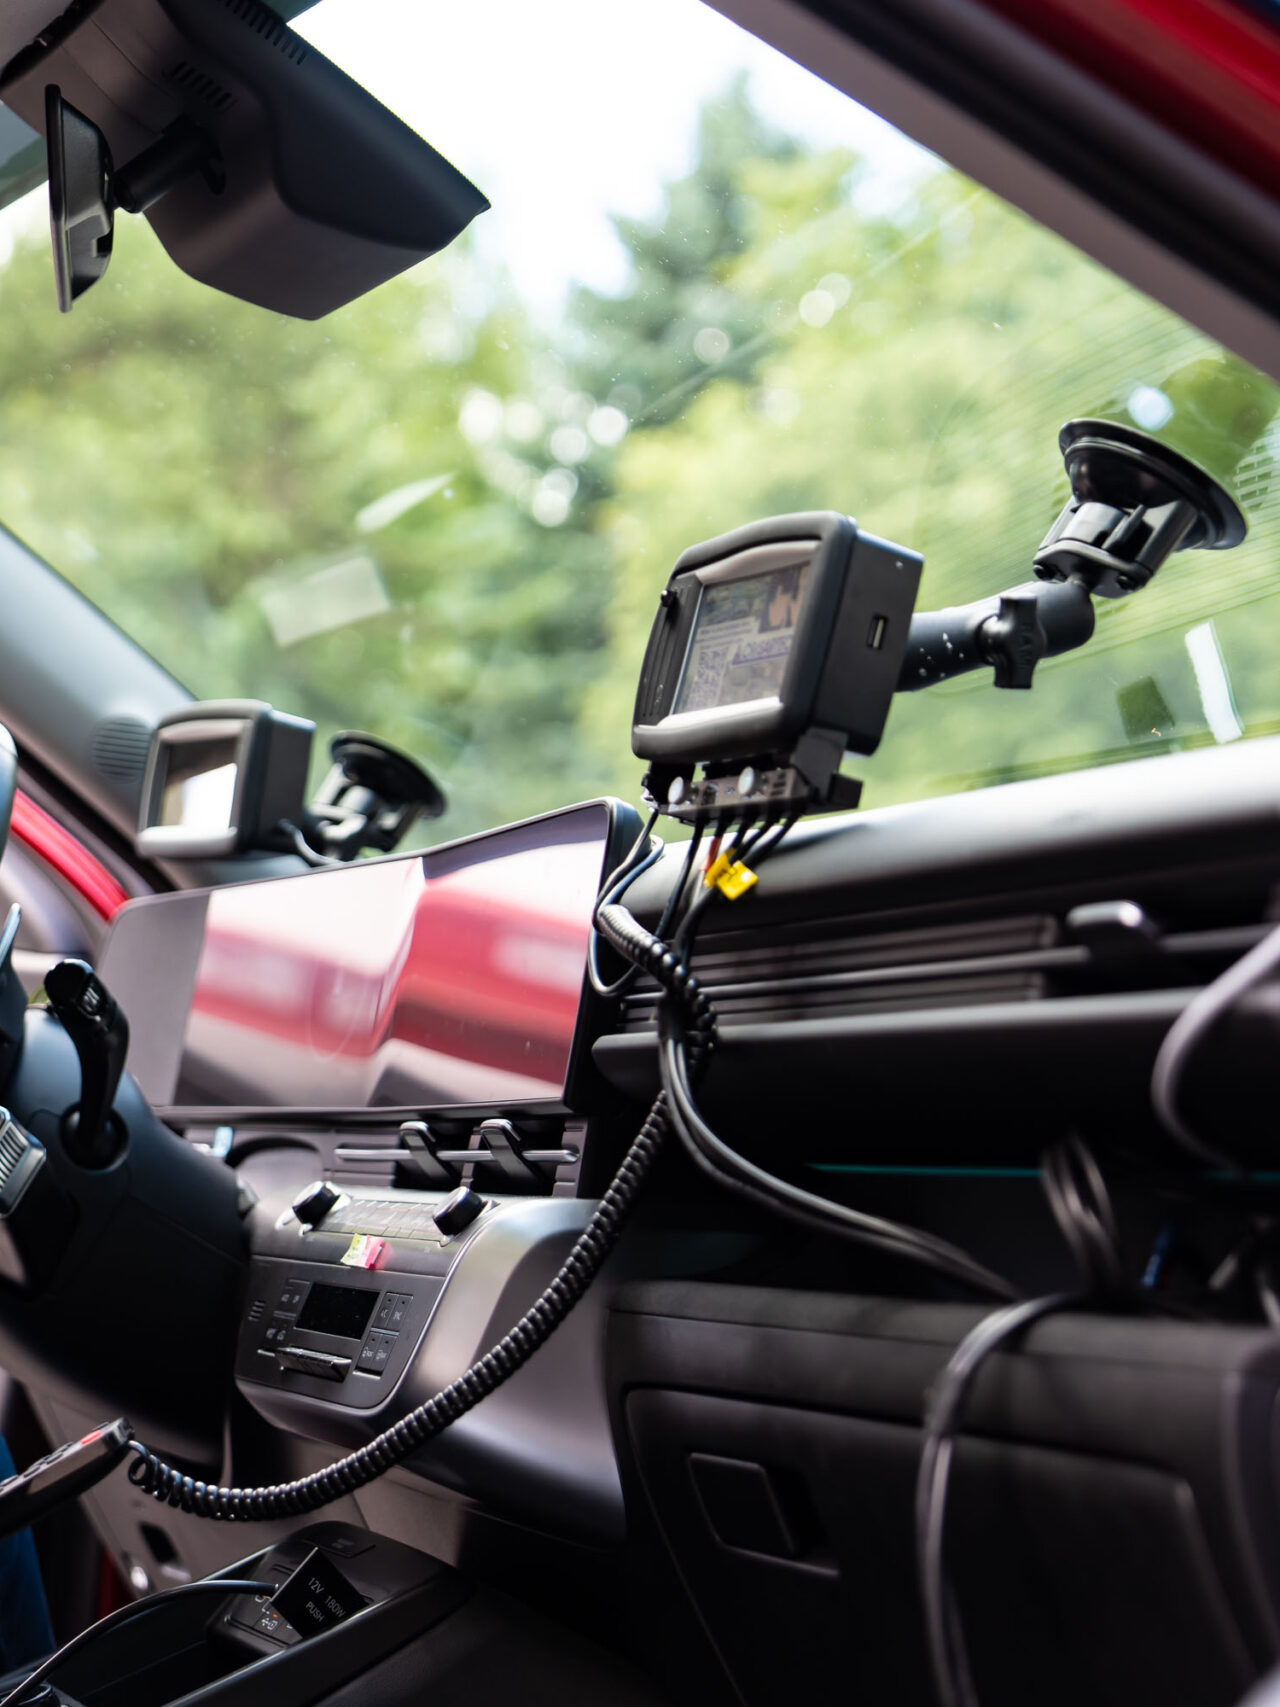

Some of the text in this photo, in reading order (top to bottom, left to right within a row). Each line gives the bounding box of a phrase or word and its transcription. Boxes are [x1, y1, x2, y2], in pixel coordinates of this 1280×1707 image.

[306, 1602, 325, 1622] PUSH
[308, 1578, 346, 1618] 12V 180W
